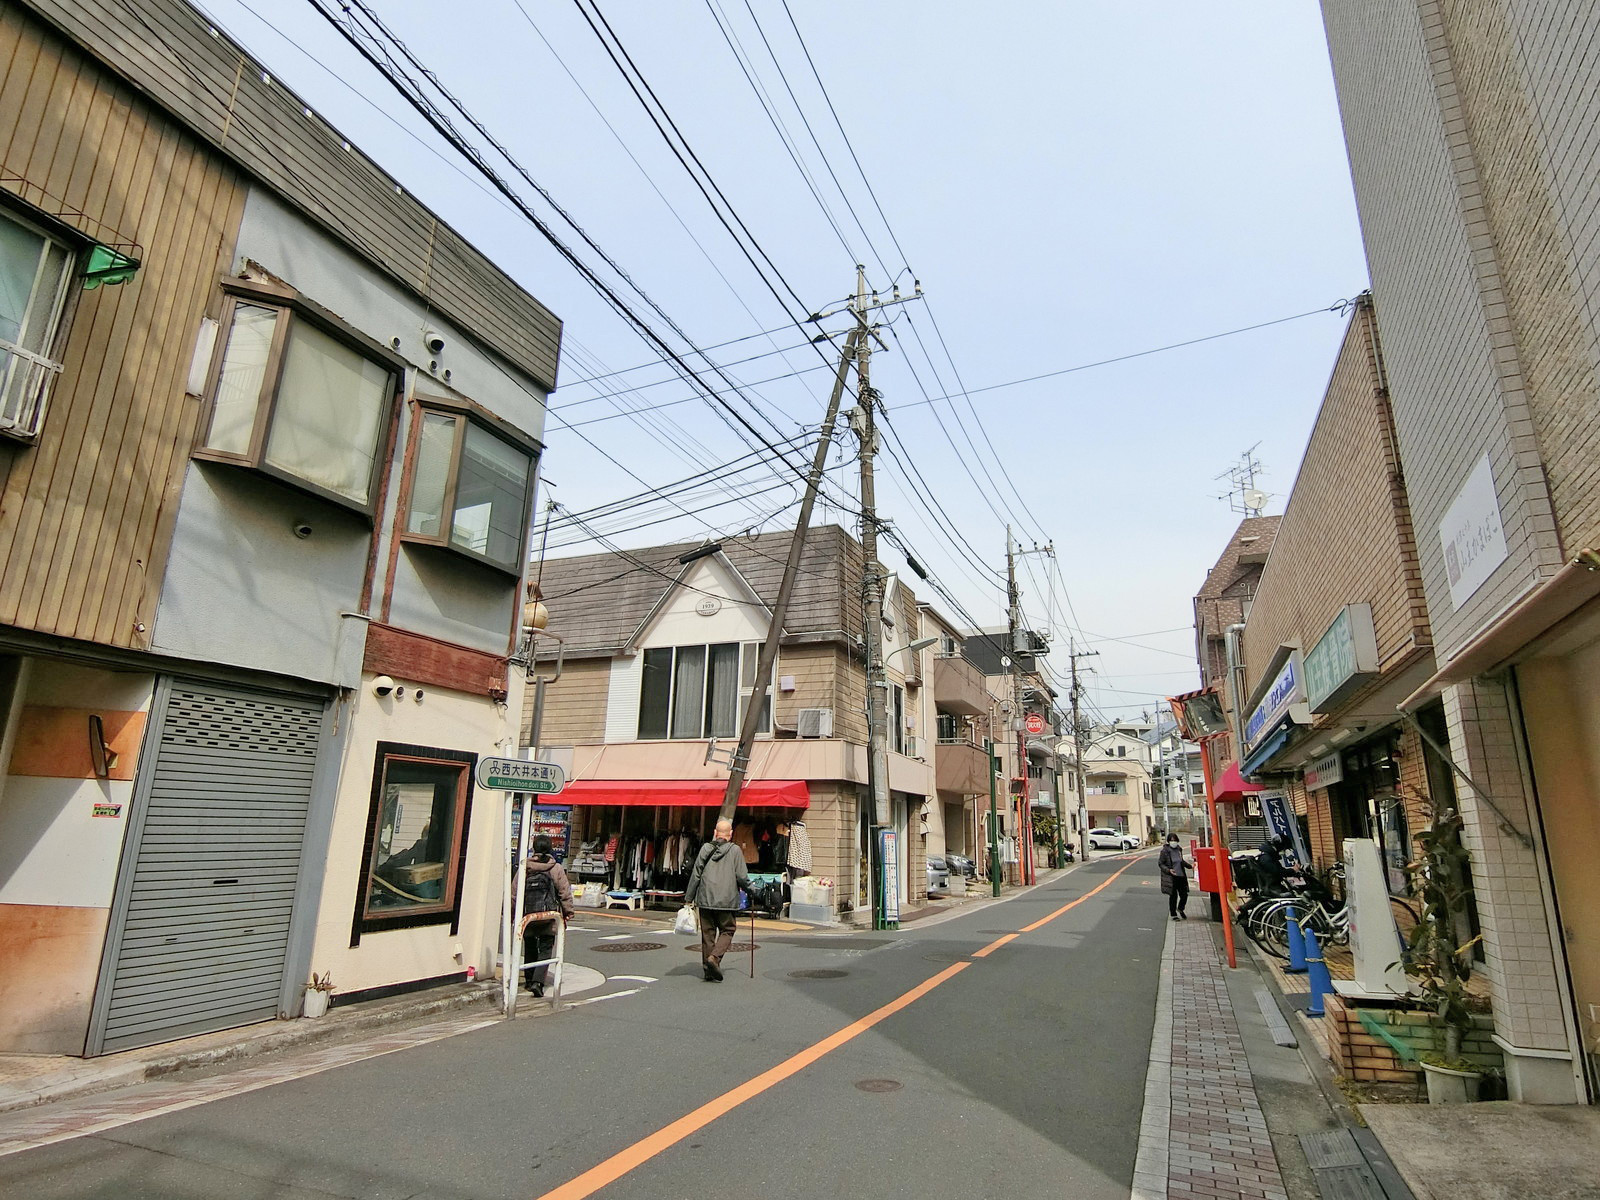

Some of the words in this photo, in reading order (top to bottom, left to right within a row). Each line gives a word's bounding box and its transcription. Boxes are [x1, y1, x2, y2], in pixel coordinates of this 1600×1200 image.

[502, 763, 556, 779] 西大井本通り
